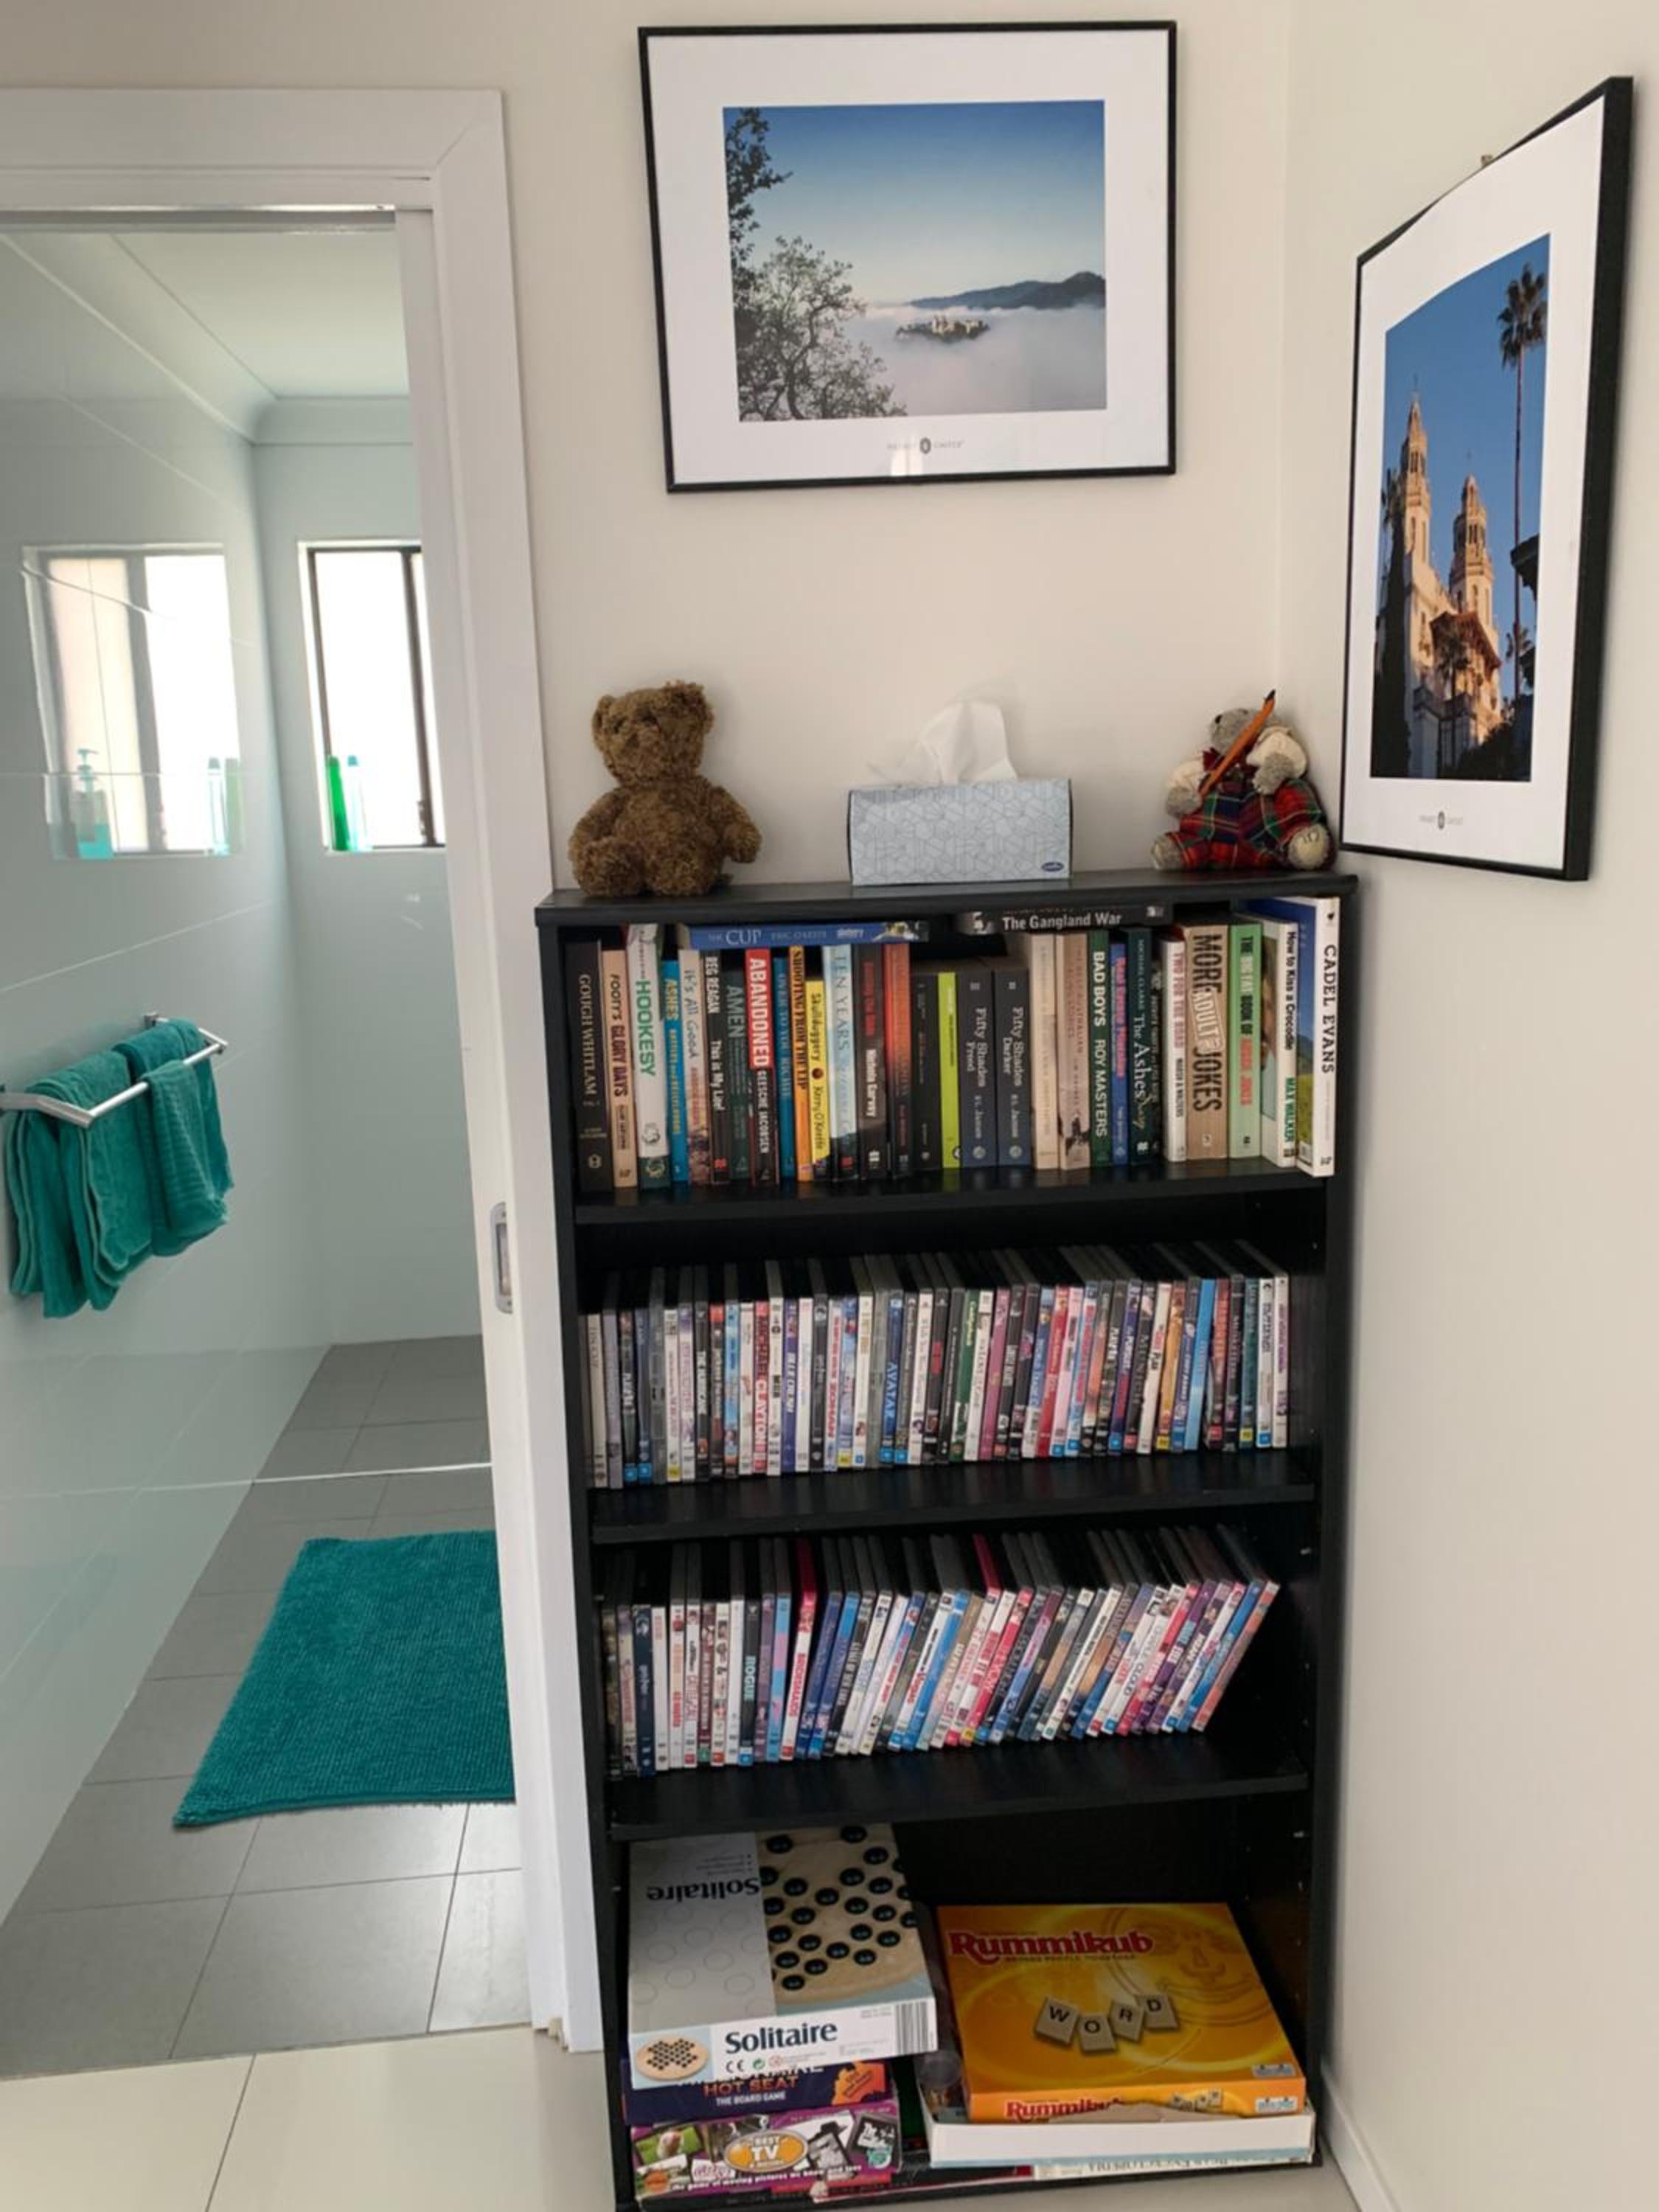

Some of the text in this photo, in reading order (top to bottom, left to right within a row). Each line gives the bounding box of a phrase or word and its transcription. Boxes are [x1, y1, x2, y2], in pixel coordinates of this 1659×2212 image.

[1003, 912, 1121, 931] The Gangland War
[1242, 935, 1253, 953] THE
[1286, 931, 1295, 953] How
[793, 950, 805, 1008] SHOOTING
[1286, 957, 1295, 966] to
[1286, 969, 1295, 991] Kiss
[726, 985, 745, 1037] AMEN
[1093, 951, 1107, 1026] BAD BOYS
[1321, 944, 1337, 1074] CADEL EVANS
[579, 973, 598, 1096] GOUGH WHITLAM
[636, 980, 658, 1077] HOOKESY
[749, 959, 770, 1066] ABANDONED
[837, 995, 851, 1051] YEARS
[1190, 934, 1224, 1112] MORE ADULT JOKES
[1285, 1004, 1296, 1051] Crocodile
[611, 1024, 627, 1062] GLORY
[975, 1041, 989, 1088] Shades
[1012, 1040, 1025, 1087] Shades
[1133, 1013, 1153, 1098] The Ashes
[613, 1065, 628, 1097] DAYS
[1094, 1039, 1108, 1138] ROY MASTERS
[755, 1380, 767, 1444] CLAYTON
[884, 1361, 898, 1419] AVATAR
[742, 1655, 757, 1703] ROGUE
[646, 1877, 760, 1901] Solitaire
[947, 1930, 1153, 1964] Rummikub
[725, 2022, 838, 2055] Solitaire
[703, 2076, 799, 2097] HOT SEAT
[717, 2097, 732, 2107] THE
[751, 2145, 779, 2162] TV
